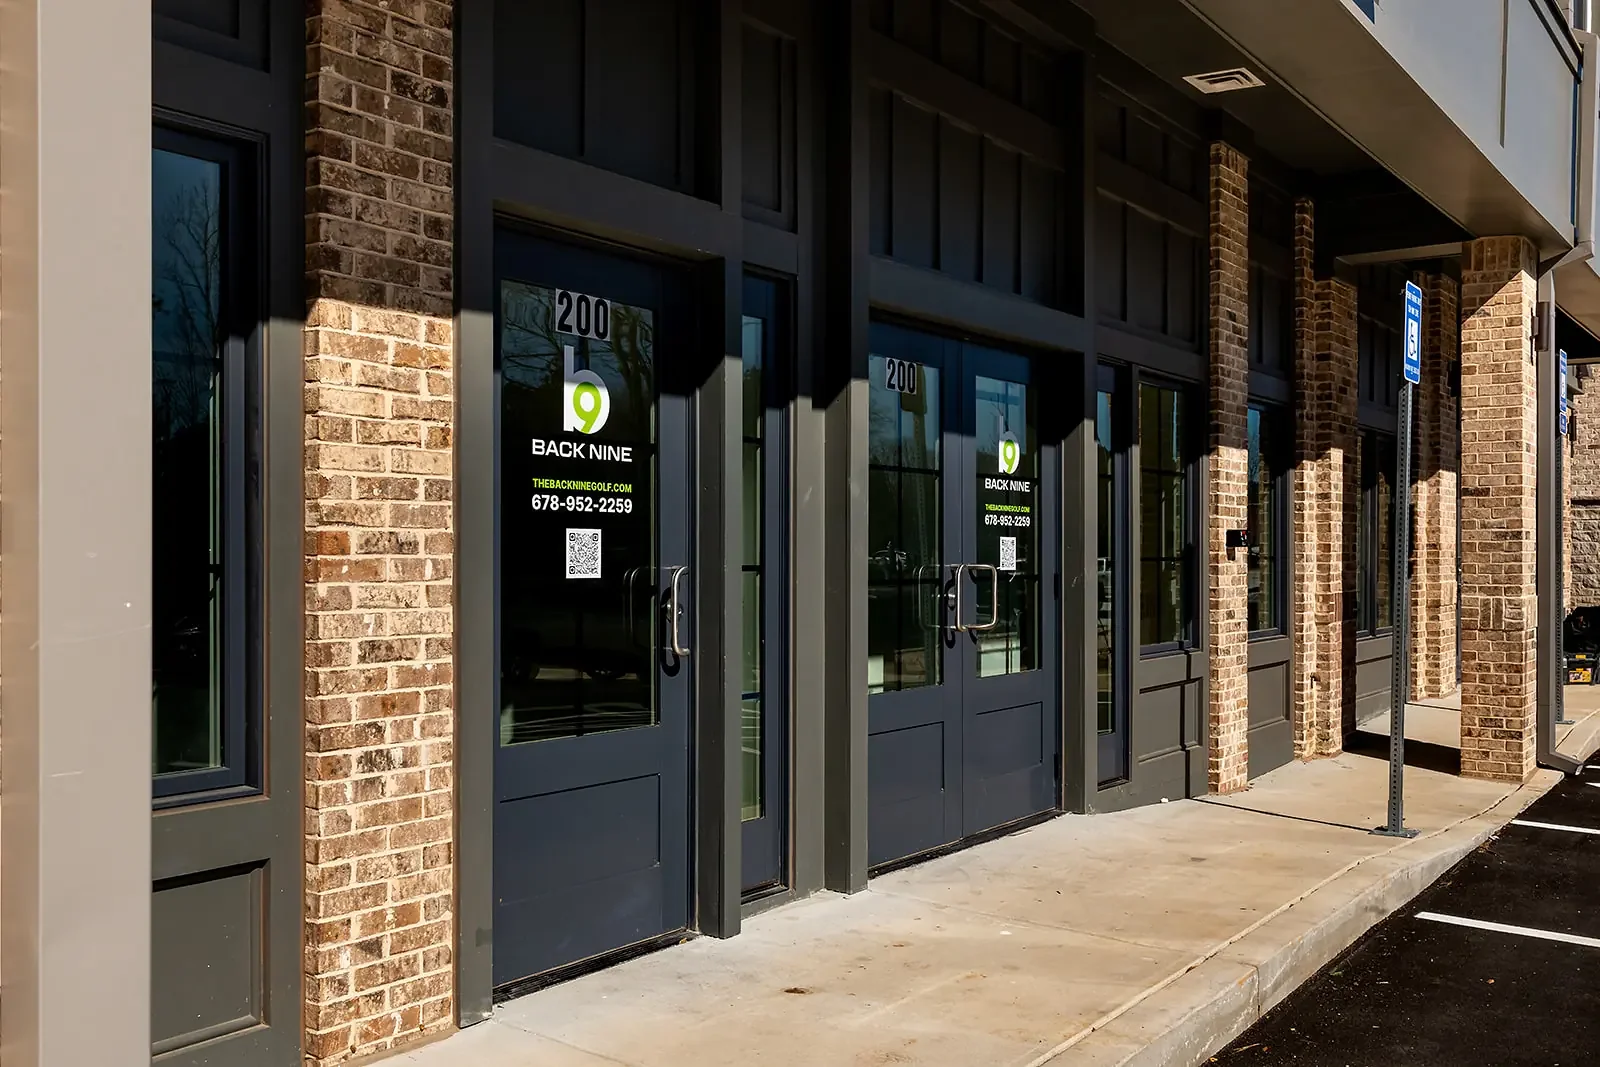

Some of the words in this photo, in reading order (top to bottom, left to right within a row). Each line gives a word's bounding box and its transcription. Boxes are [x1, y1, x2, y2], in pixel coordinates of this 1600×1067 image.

[556, 290, 610, 340] 200
[886, 358, 917, 393] 200
[532, 438, 586, 459] BACK
[589, 443, 633, 463] NINE
[532, 478, 632, 493] THEBACKNINEGOLF.COM
[984, 477, 1009, 491] BACK
[1009, 480, 1031, 493] NINE
[531, 493, 633, 514] 678-952-2259
[984, 513, 1031, 527] 678-952-2259
